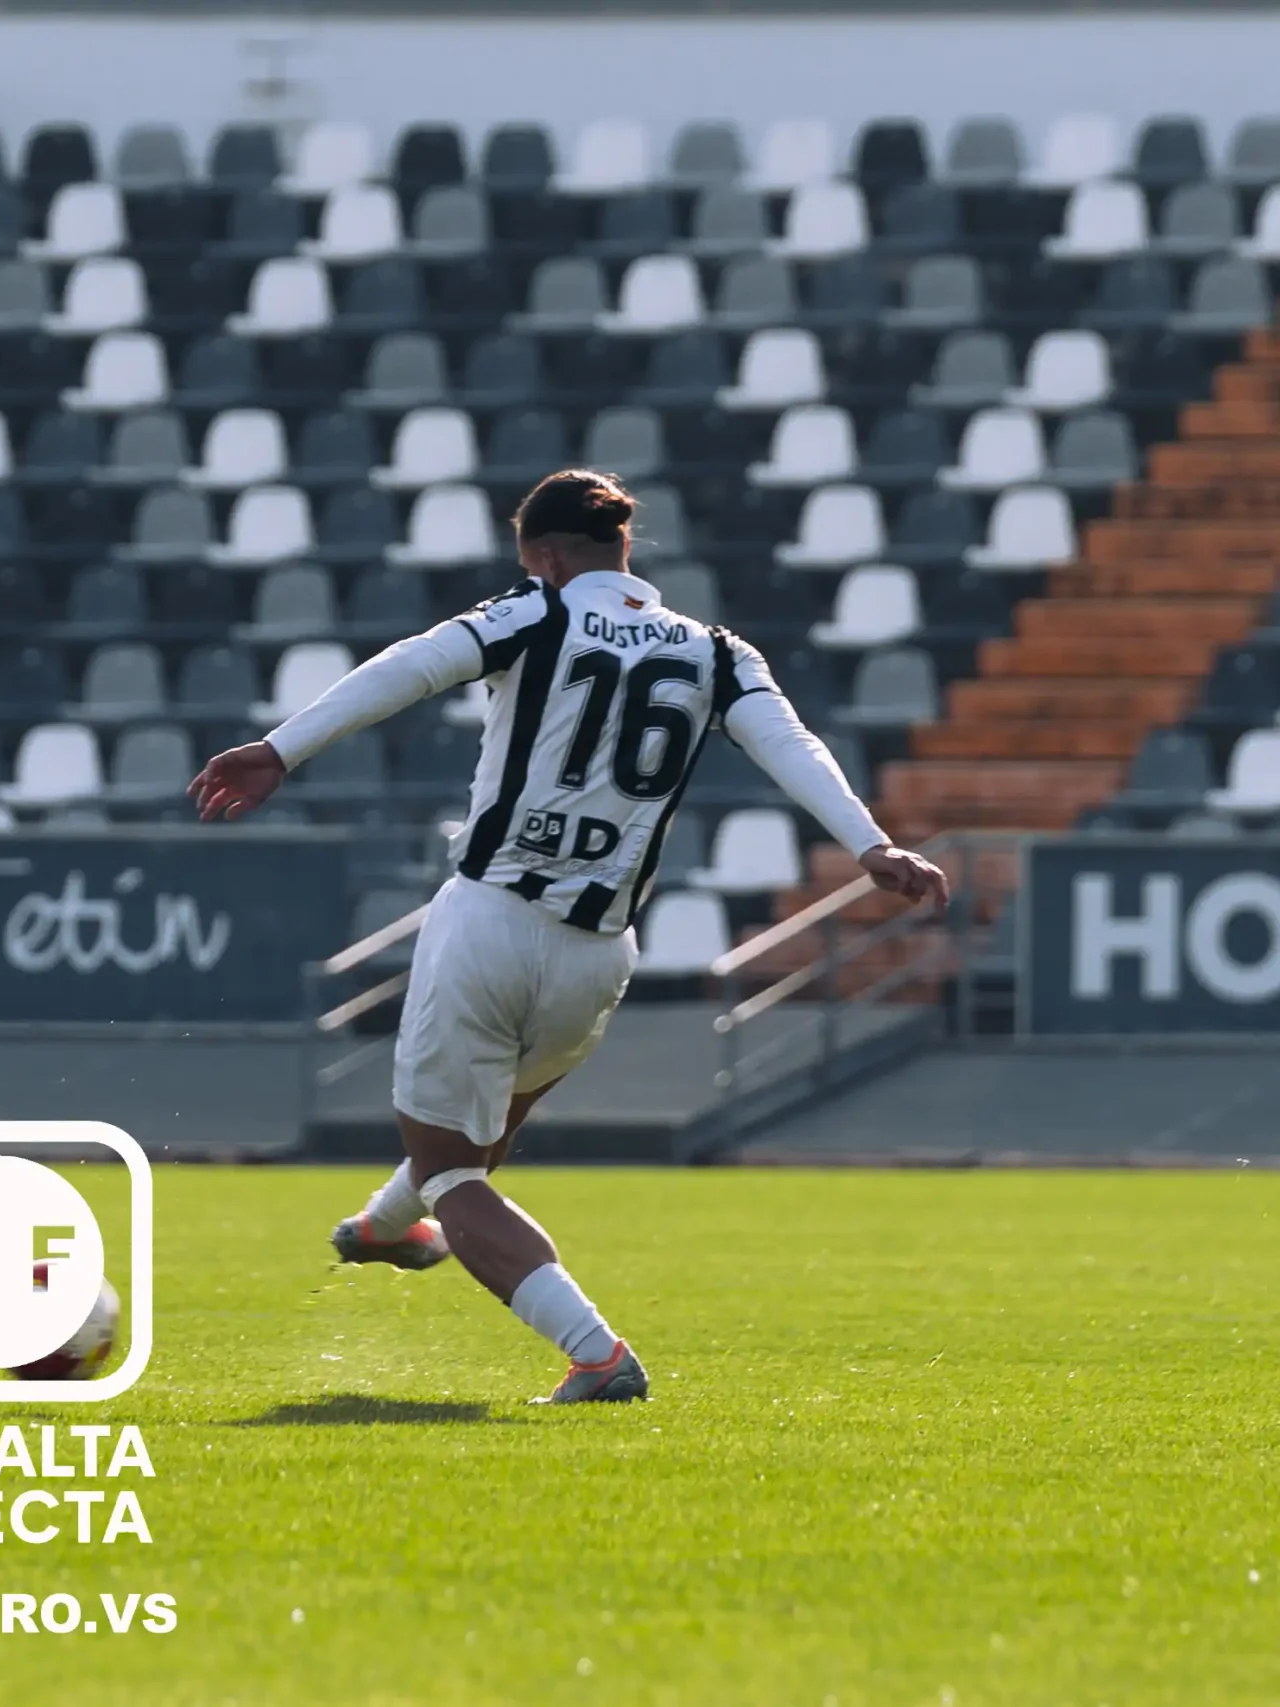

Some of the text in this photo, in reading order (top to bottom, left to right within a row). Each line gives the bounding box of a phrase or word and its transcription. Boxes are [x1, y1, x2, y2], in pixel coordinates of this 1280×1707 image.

[584, 611, 688, 649] GUSTAVO
[557, 646, 704, 801] 16
[1071, 871, 1280, 1002] HO
